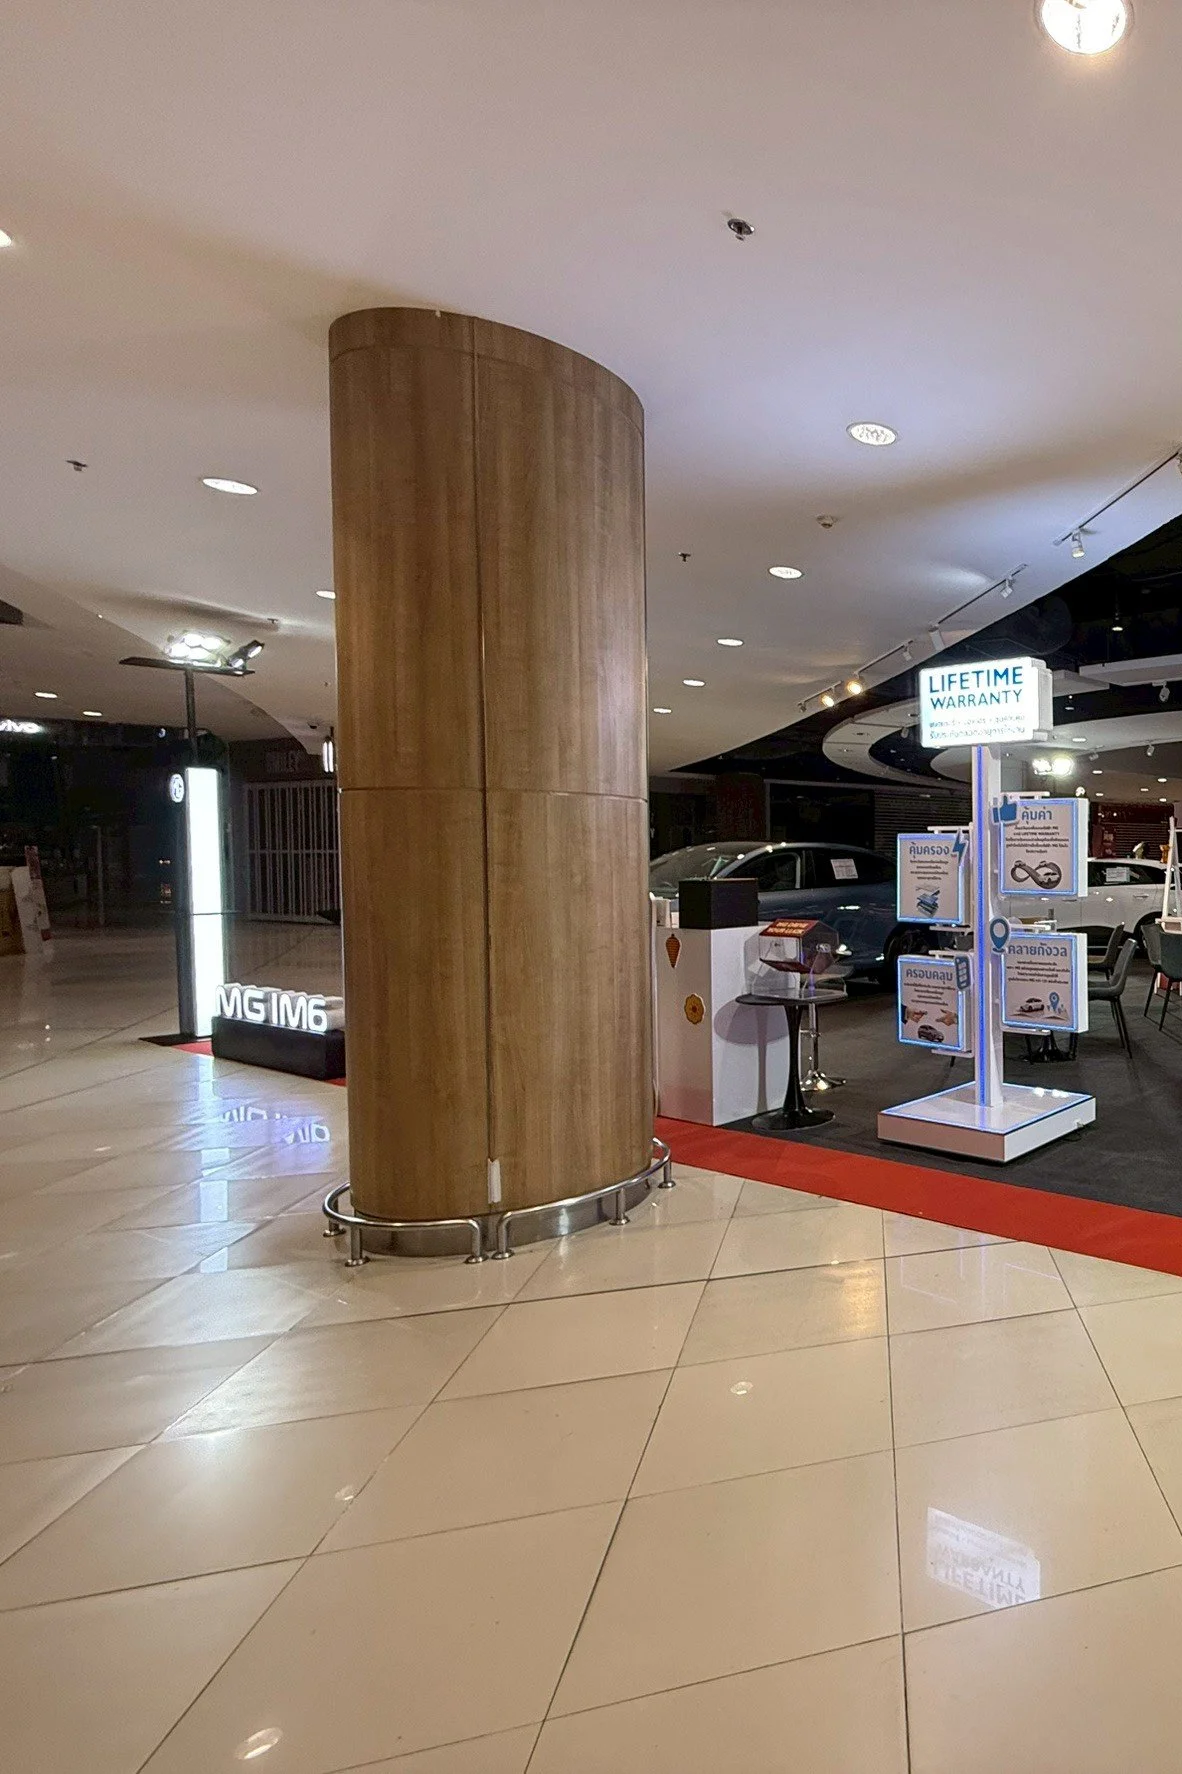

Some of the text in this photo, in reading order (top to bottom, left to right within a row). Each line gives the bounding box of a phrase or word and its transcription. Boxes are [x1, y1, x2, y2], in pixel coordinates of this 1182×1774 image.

[929, 666, 1023, 694] LIFETIME
[930, 689, 1022, 710] WARRANTY
[1021, 806, 1053, 825] คุ้มค่า
[909, 842, 950, 859] คุ้มครอง
[1008, 942, 1068, 957] คลายกังวล
[906, 968, 953, 985] ครอบคลุม
[215, 985, 328, 1033] MG IM6
